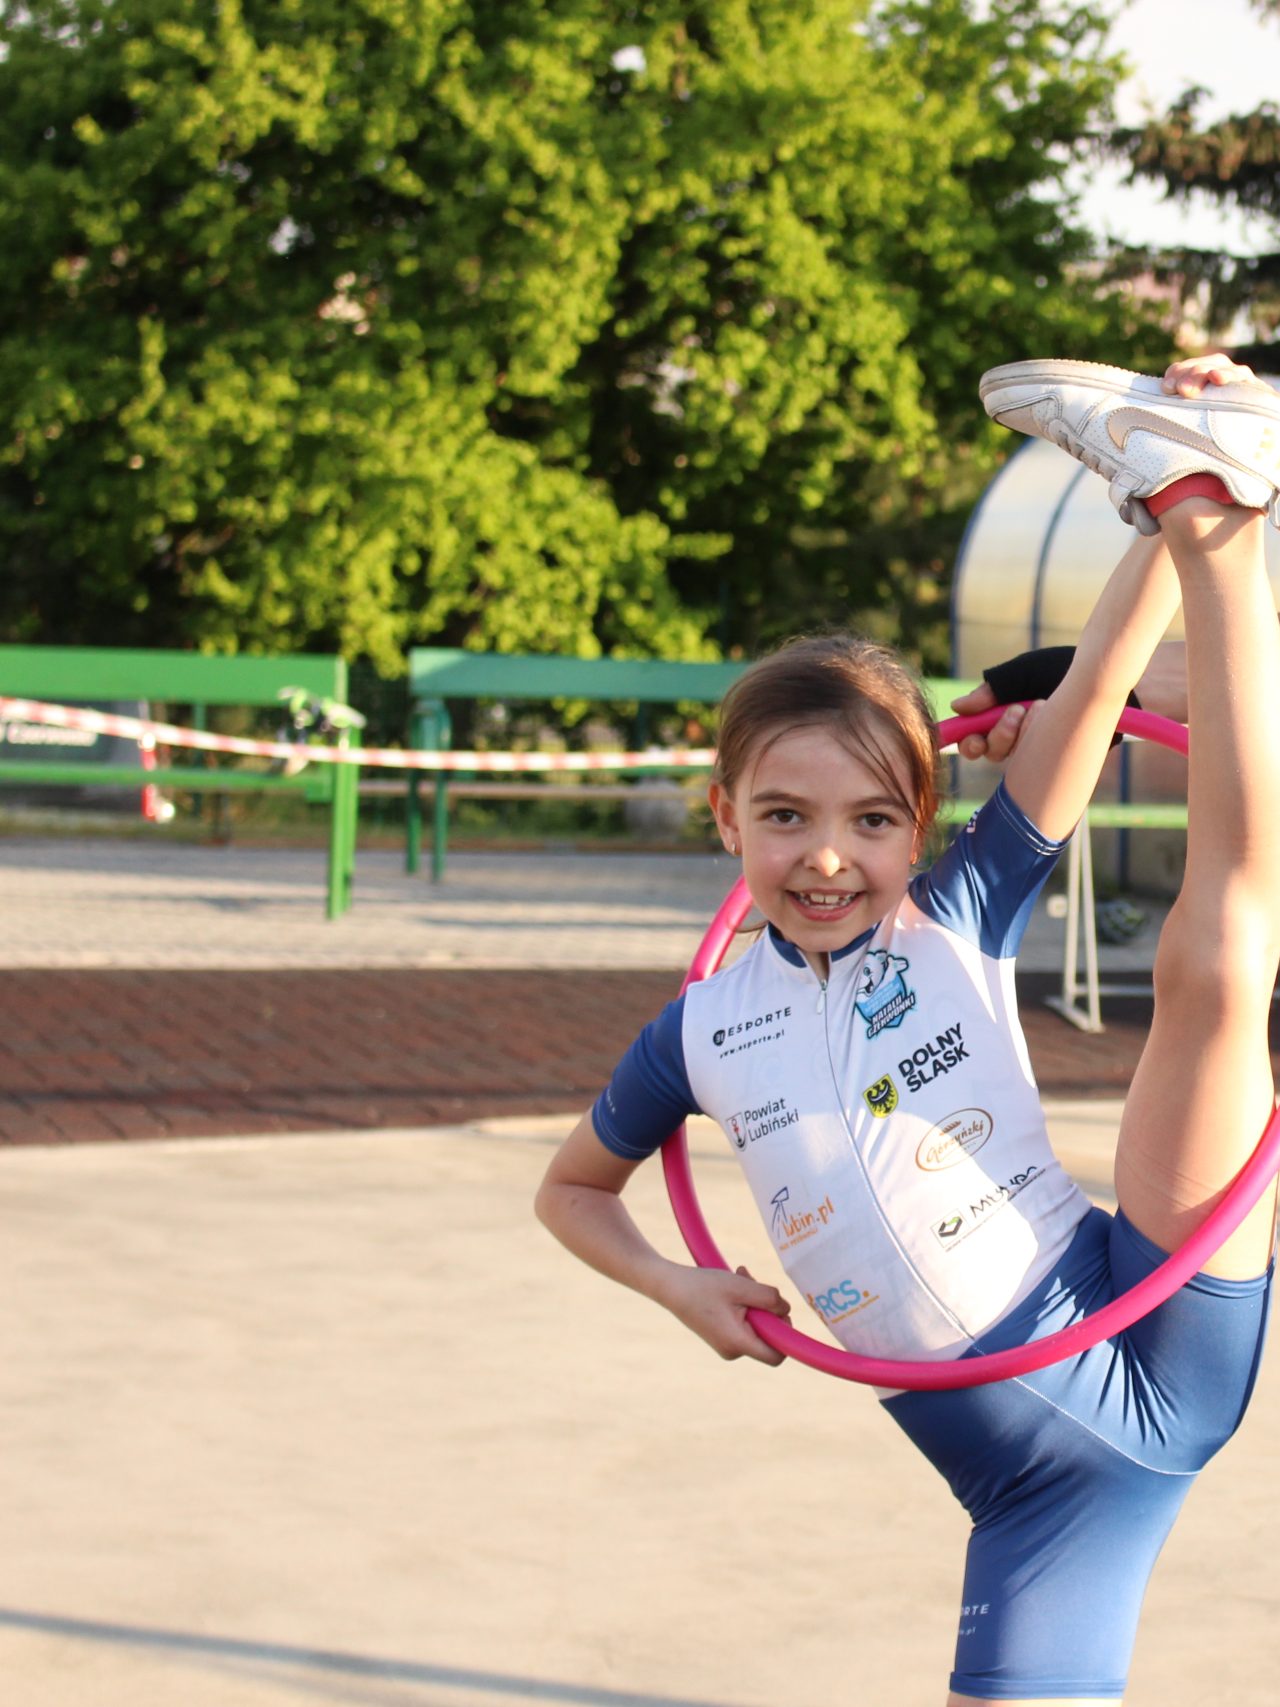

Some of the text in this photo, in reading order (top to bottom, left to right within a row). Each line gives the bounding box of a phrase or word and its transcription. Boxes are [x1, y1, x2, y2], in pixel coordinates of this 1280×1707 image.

[727, 1006, 792, 1037] ESPORTE
[898, 1022, 963, 1078] DOLNY
[744, 1097, 785, 1124] Powiat
[748, 1108, 799, 1142] Lubiński
